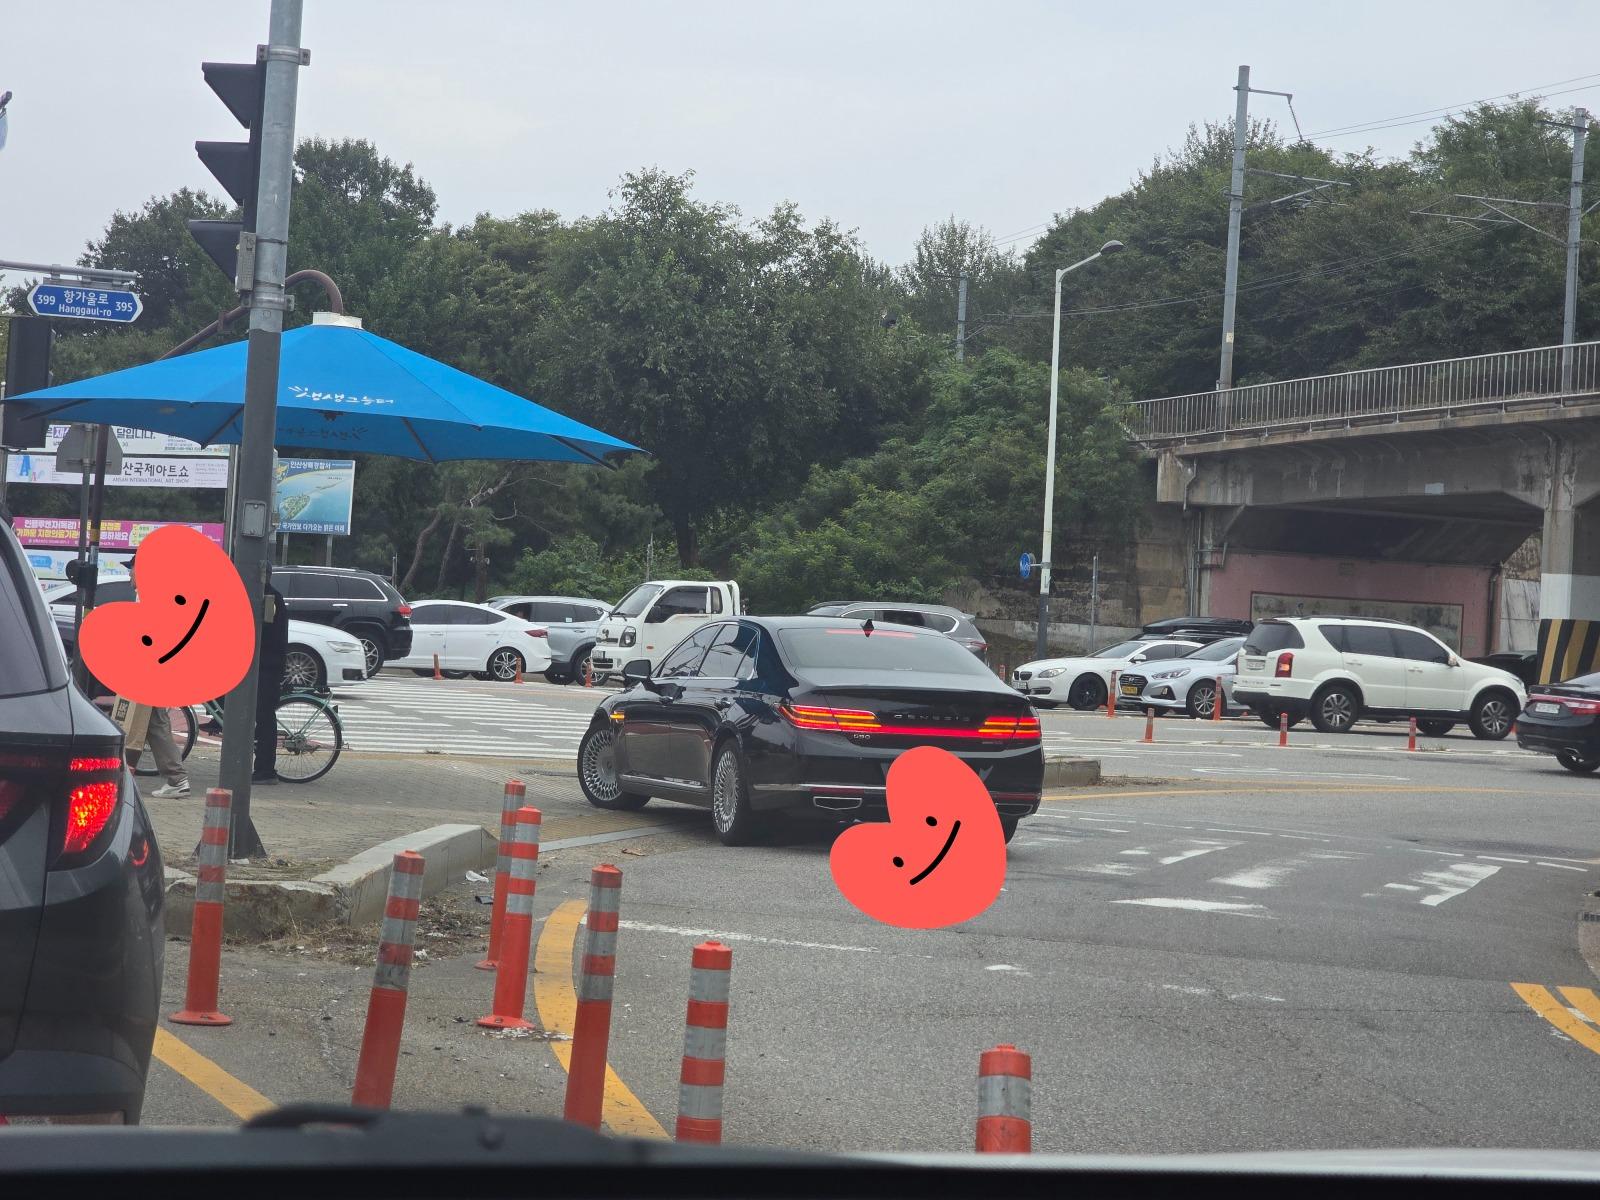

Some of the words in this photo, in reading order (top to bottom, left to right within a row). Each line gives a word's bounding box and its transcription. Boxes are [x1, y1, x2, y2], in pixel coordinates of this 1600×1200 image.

[37, 294, 56, 305] 399
[63, 289, 109, 307] 항가을로
[58, 303, 112, 316] Hanggaul-ro
[115, 301, 133, 312] 395
